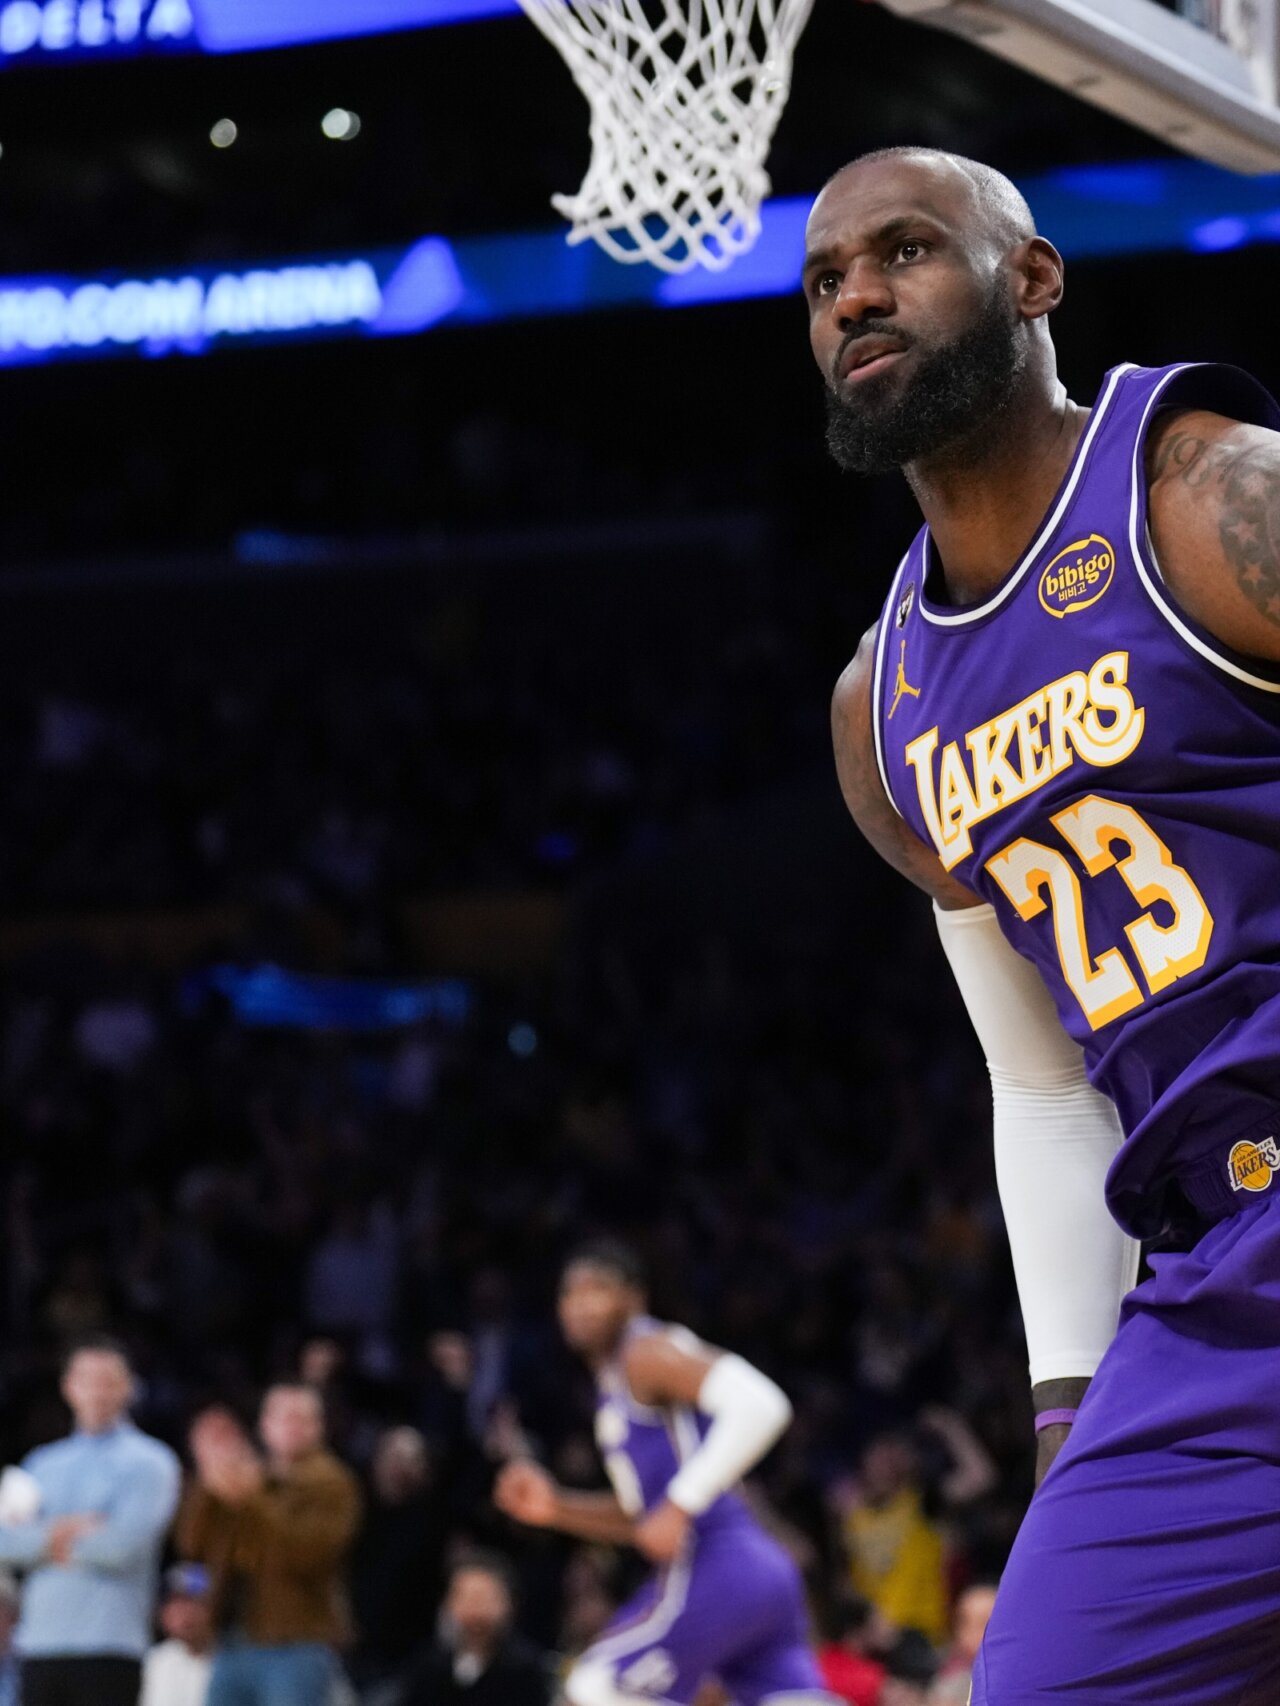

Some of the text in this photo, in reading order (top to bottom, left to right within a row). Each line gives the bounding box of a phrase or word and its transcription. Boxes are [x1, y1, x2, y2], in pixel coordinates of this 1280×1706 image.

[0, 0, 194, 53] DELTA
[1045, 553, 1110, 596] bibigo
[1058, 581, 1087, 602] 비비고
[905, 651, 1146, 873] LAKERS
[983, 794, 1215, 1032] 23
